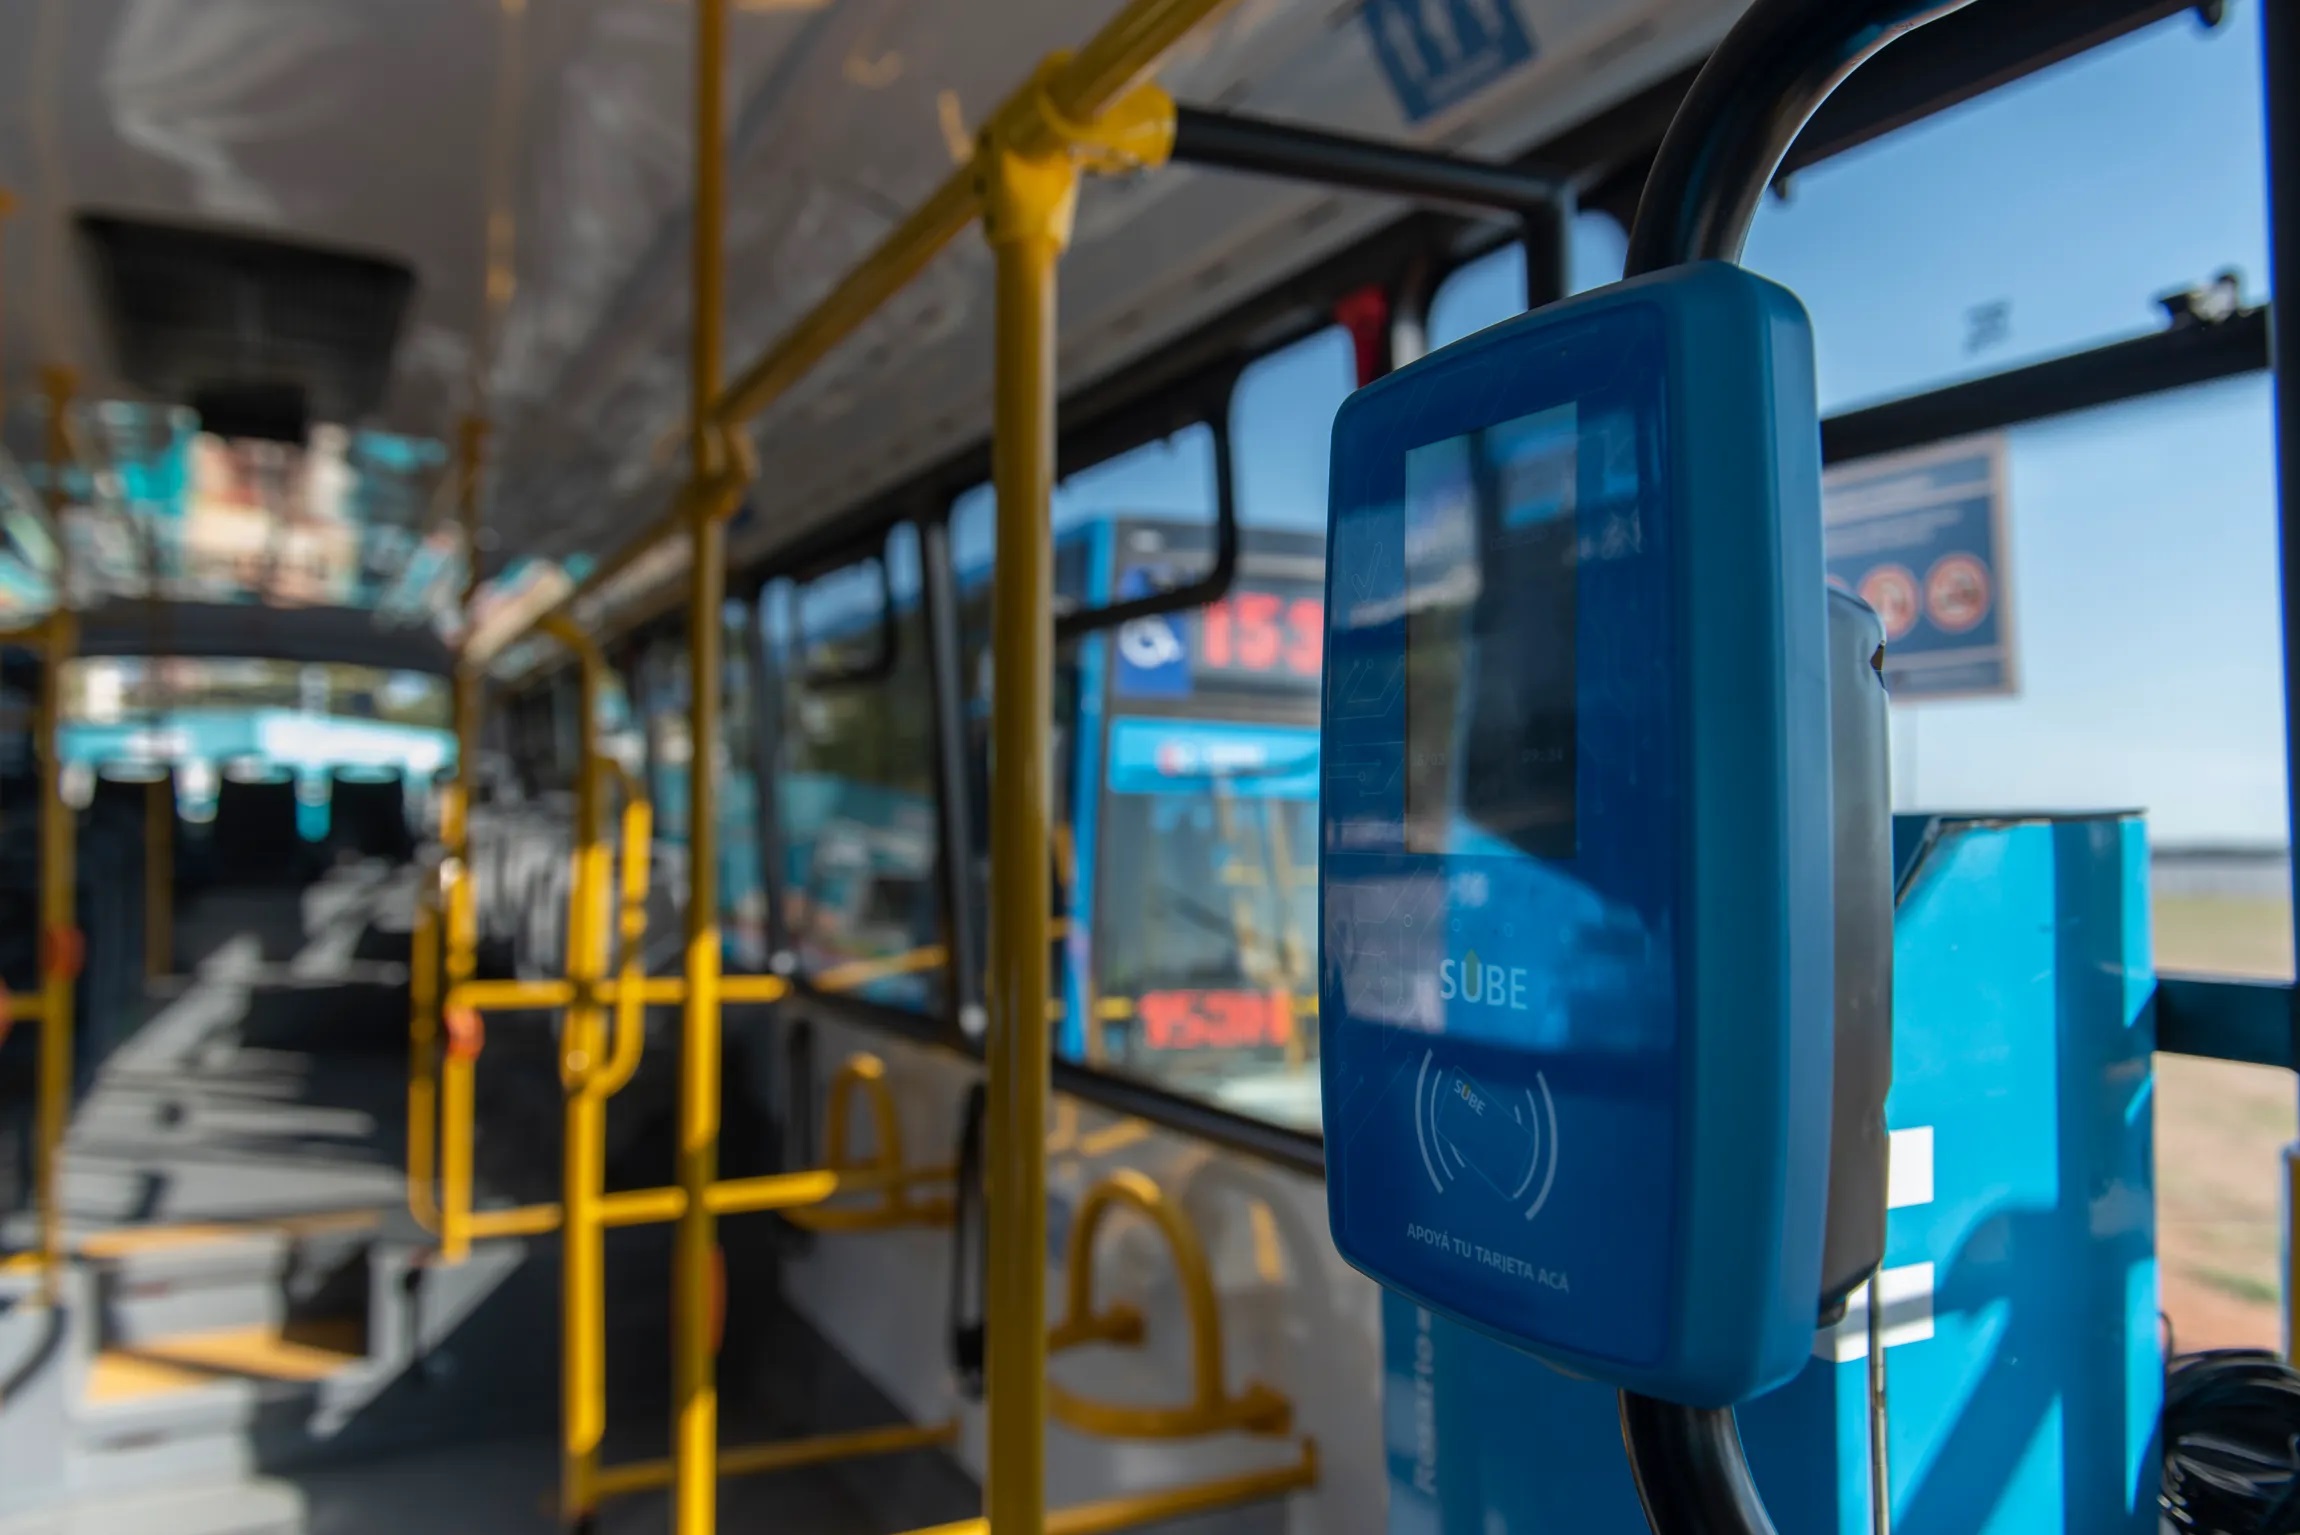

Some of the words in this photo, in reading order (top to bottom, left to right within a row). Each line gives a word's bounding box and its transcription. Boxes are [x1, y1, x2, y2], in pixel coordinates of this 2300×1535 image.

[1439, 948, 1528, 1010] SUBE
[1453, 1079, 1486, 1117] SUBE
[1406, 1222, 1450, 1251] APOYÁ
[1453, 1237, 1472, 1258] TU
[1474, 1245, 1534, 1281] TARJETA
[1537, 1267, 1569, 1294] ACÁ
